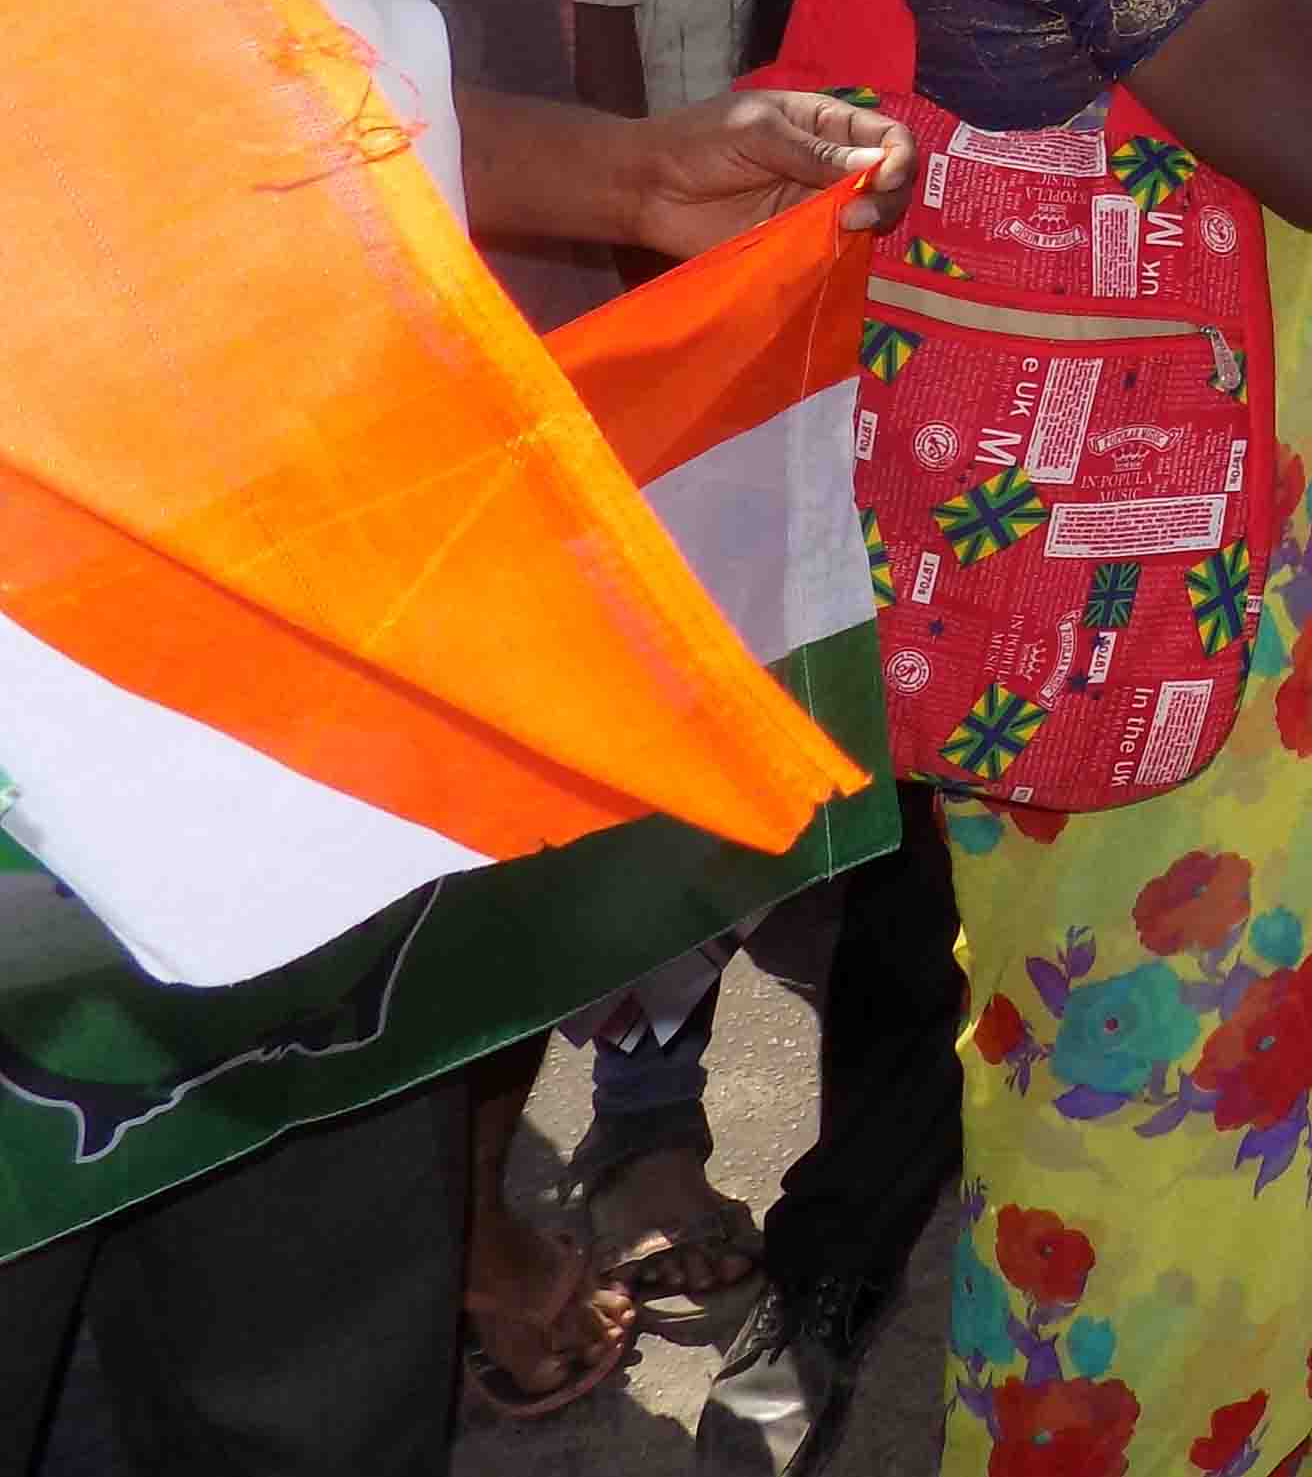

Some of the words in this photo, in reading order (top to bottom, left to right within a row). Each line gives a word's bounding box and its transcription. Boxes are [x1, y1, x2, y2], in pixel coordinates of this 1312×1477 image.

[1140, 260, 1160, 296] UK
[1009, 381, 1039, 417] UK
[1131, 687, 1154, 708] In
[1119, 717, 1146, 754] the
[1111, 761, 1135, 787] UK
